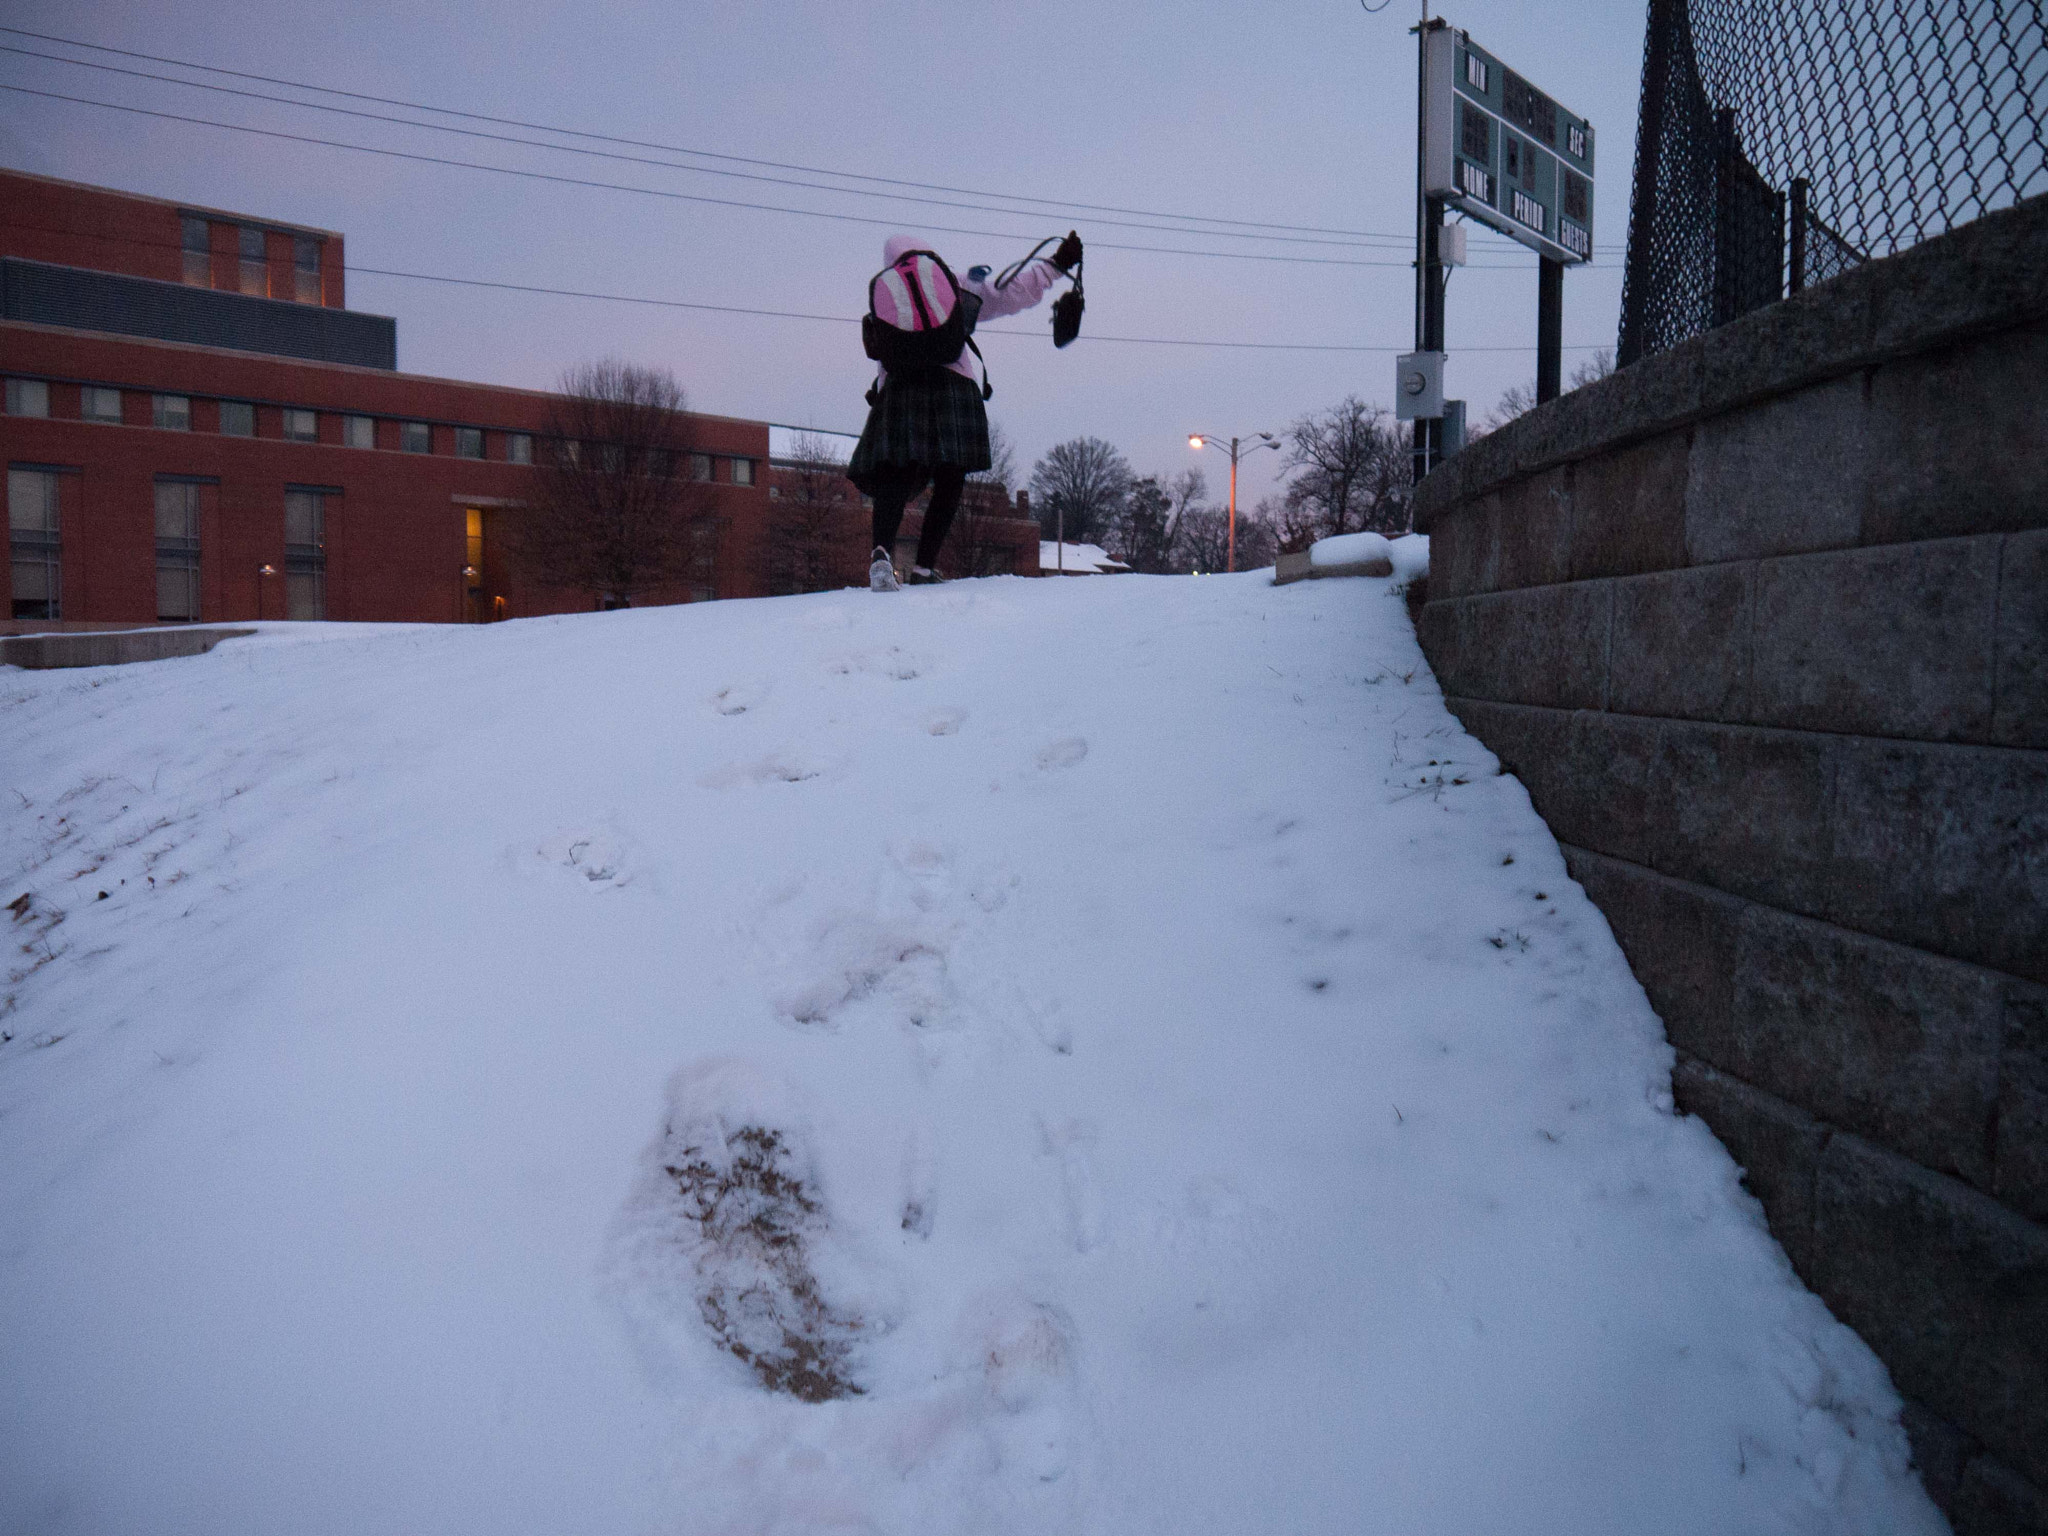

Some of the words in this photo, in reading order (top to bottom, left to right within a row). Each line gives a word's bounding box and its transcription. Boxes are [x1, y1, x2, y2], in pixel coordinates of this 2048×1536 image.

[1569, 126, 1584, 159] SEC
[1463, 161, 1489, 202] HOME
[1514, 190, 1544, 232] PERIOD
[1561, 219, 1588, 255] GUESTS
